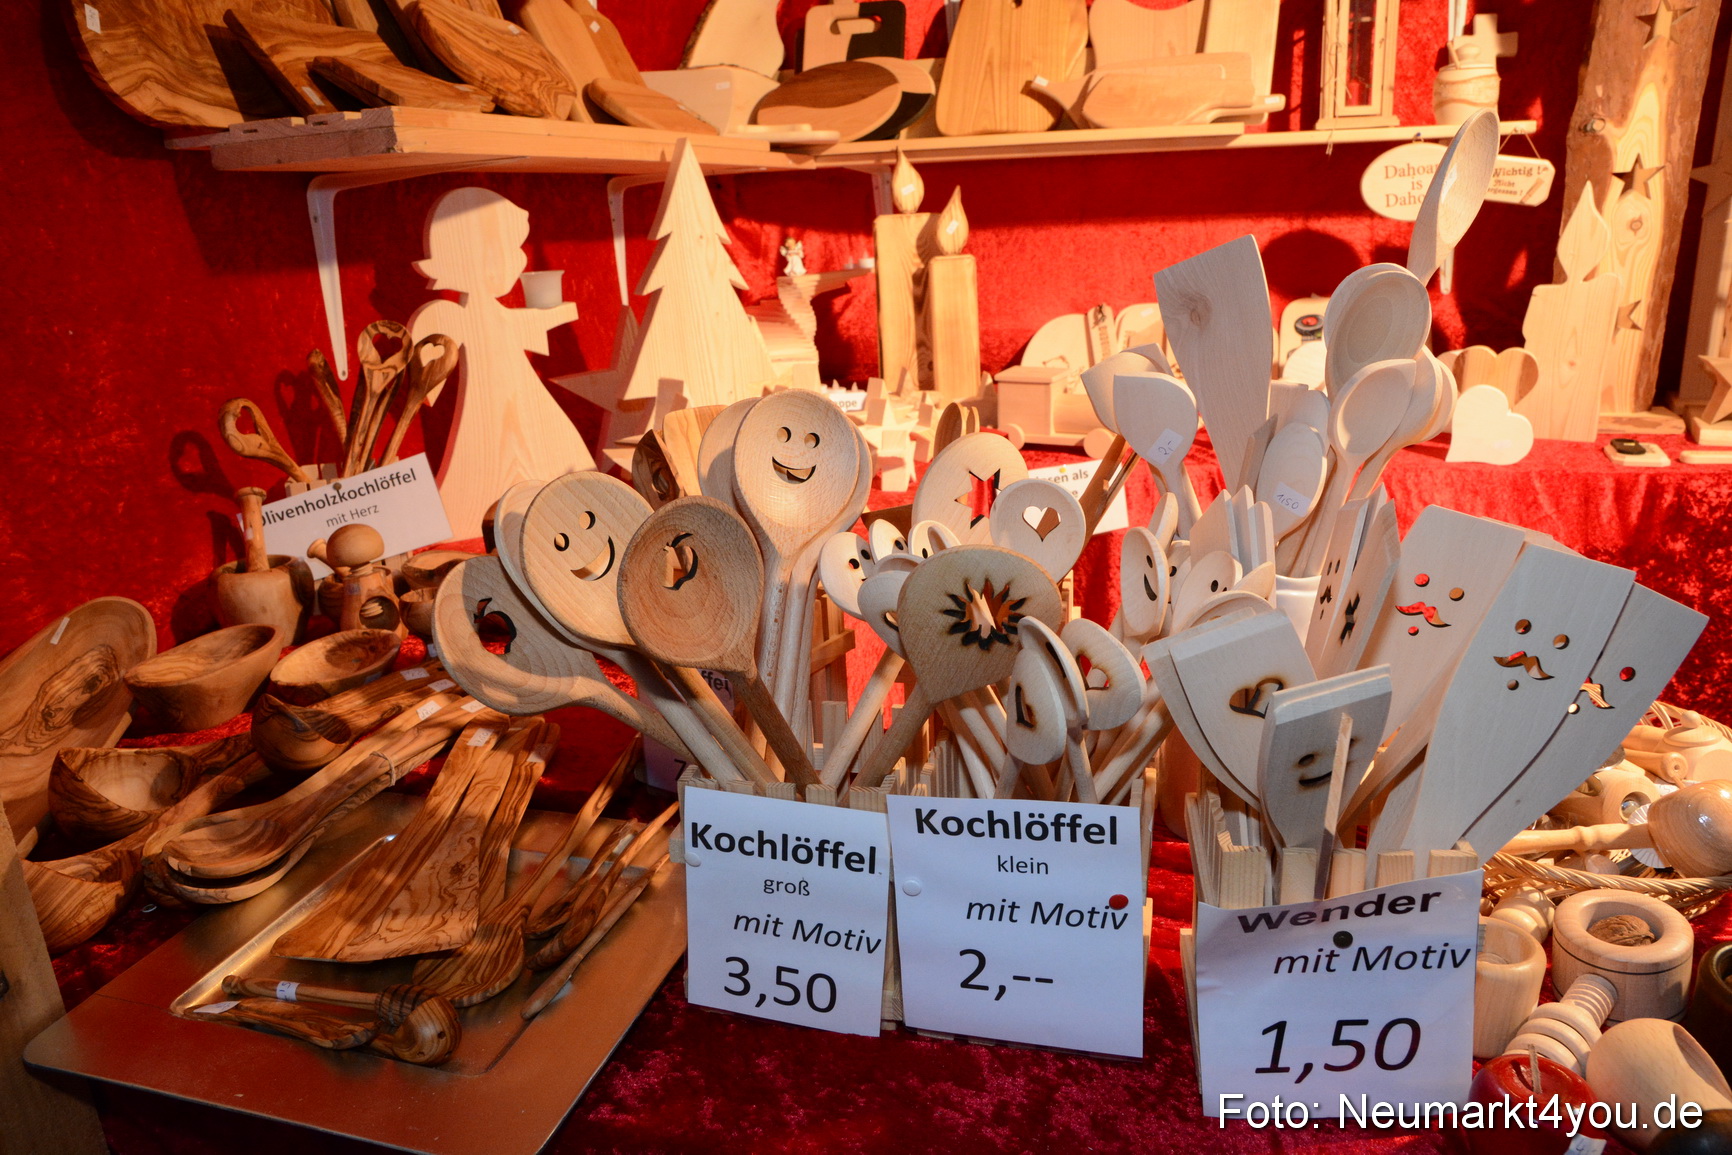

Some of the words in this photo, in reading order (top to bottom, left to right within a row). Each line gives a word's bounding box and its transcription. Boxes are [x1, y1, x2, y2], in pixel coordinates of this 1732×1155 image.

[1384, 163, 1438, 180] Dahoa
[1411, 177, 1423, 191] is
[1072, 469, 1089, 480] als
[326, 514, 348, 528] mit
[350, 503, 380, 520] Herz
[915, 808, 1118, 845] Kochlöffel
[691, 822, 876, 875] Kochlöffel
[997, 855, 1049, 875] klein
[763, 878, 811, 896] groß
[966, 898, 1021, 923] mit
[1030, 901, 1129, 931] Motiv
[1238, 892, 1442, 934] Wender
[733, 914, 784, 938] mit
[792, 919, 882, 954] Motiv
[1273, 947, 1340, 974] mit
[1352, 942, 1472, 972] Motiv
[723, 956, 837, 1014] 3,50
[959, 948, 1054, 1002] 2,--
[1255, 1017, 1422, 1085] 1,50
